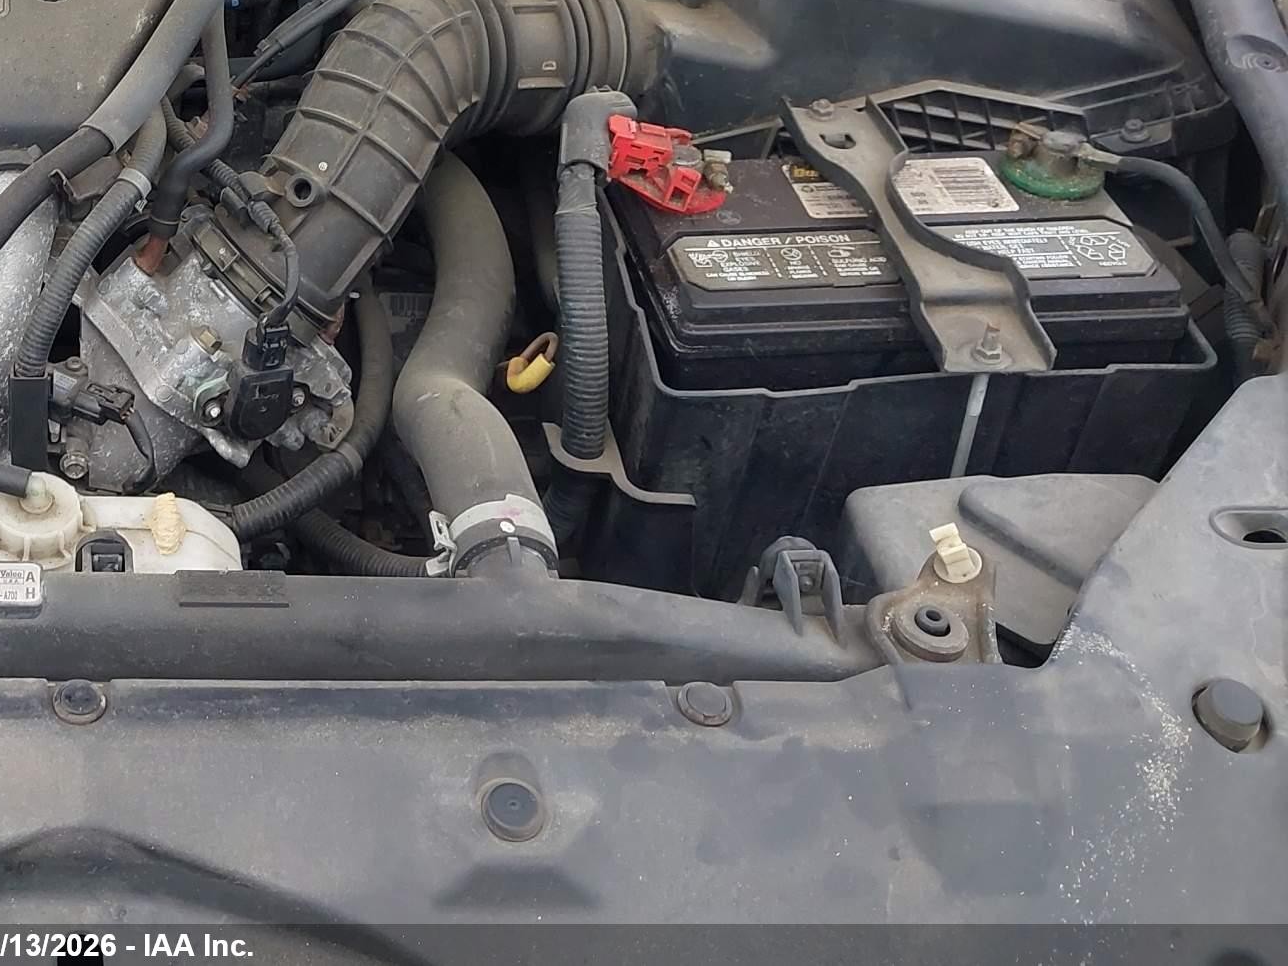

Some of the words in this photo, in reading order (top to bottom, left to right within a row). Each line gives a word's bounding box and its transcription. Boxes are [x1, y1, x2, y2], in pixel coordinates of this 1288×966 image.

[720, 237, 781, 247] DANGER
[795, 234, 851, 243] POISON
[25, 572, 35, 583] A
[25, 587, 36, 599] H
